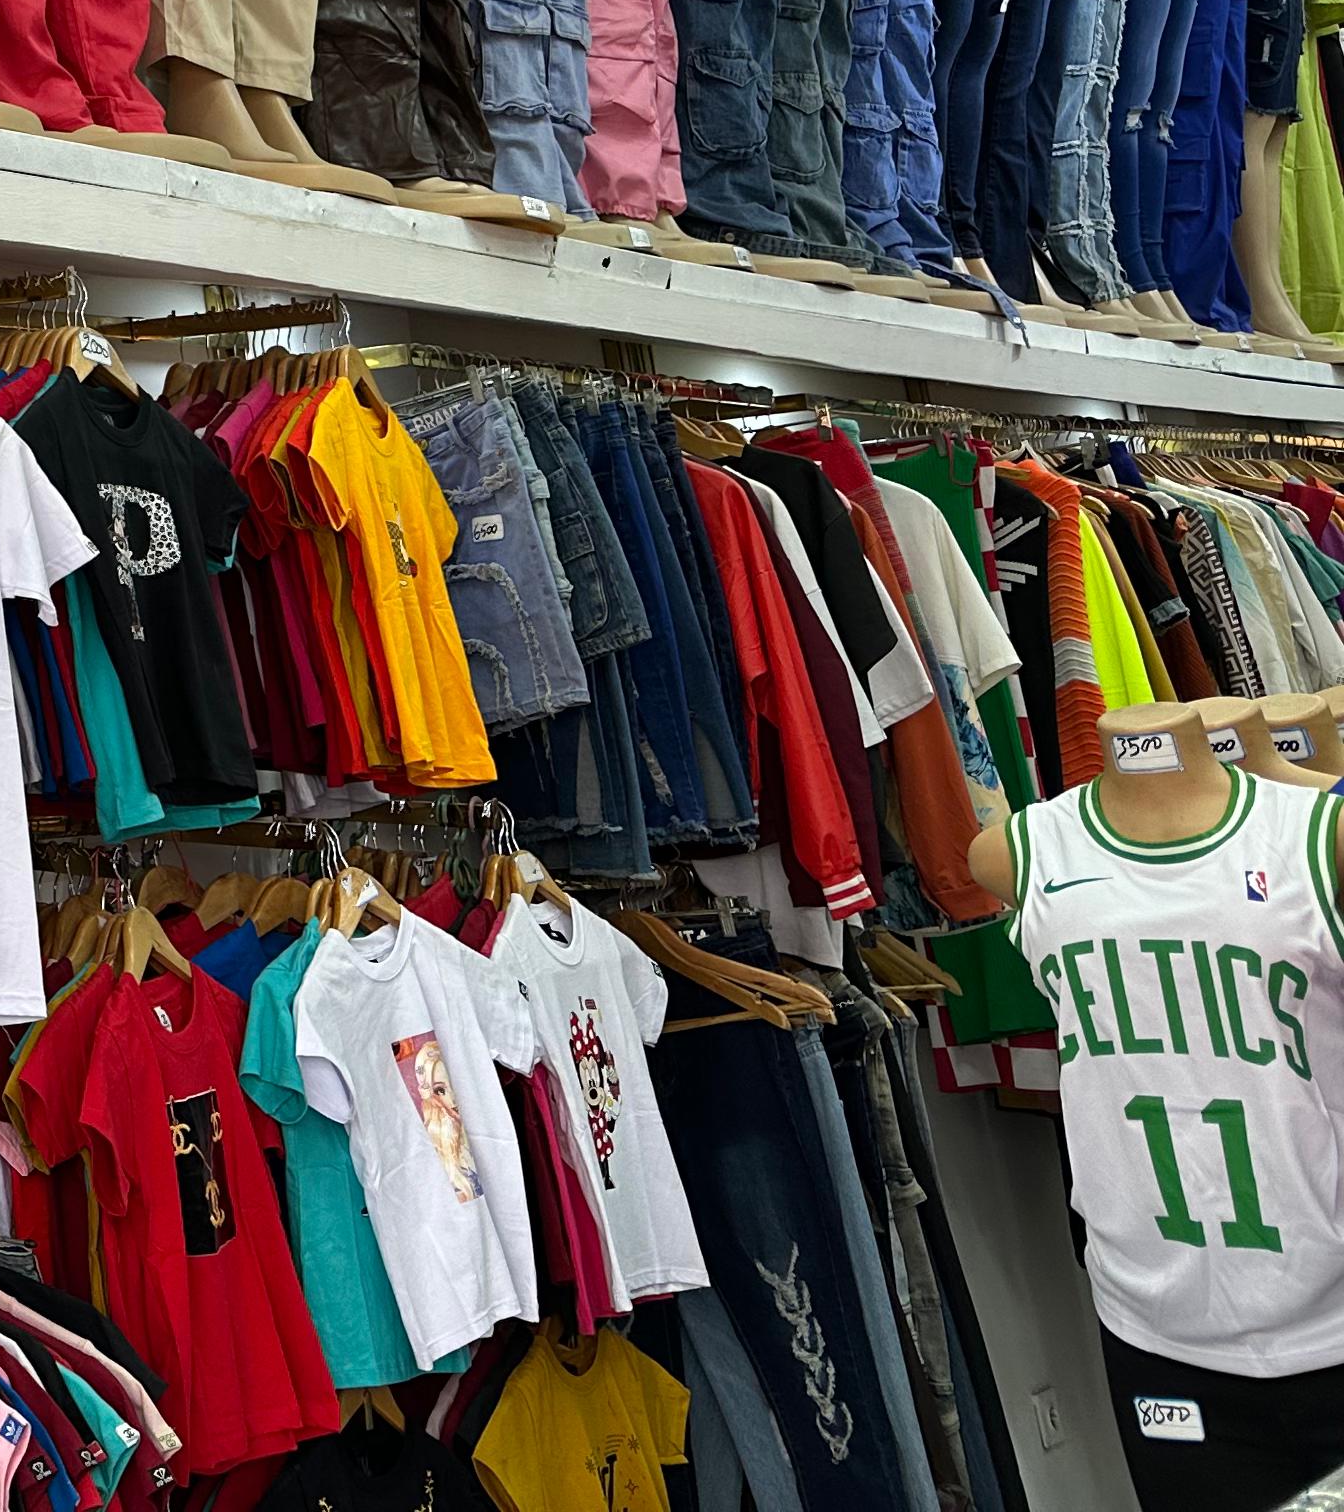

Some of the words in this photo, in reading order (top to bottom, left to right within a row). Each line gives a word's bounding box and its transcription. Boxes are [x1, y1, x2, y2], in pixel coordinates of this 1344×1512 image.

[1116, 736, 1163, 760] 3500
[1039, 937, 1312, 1082] CELTICS
[1123, 1094, 1284, 1254] 11
[1137, 1398, 1191, 1427] 8000
